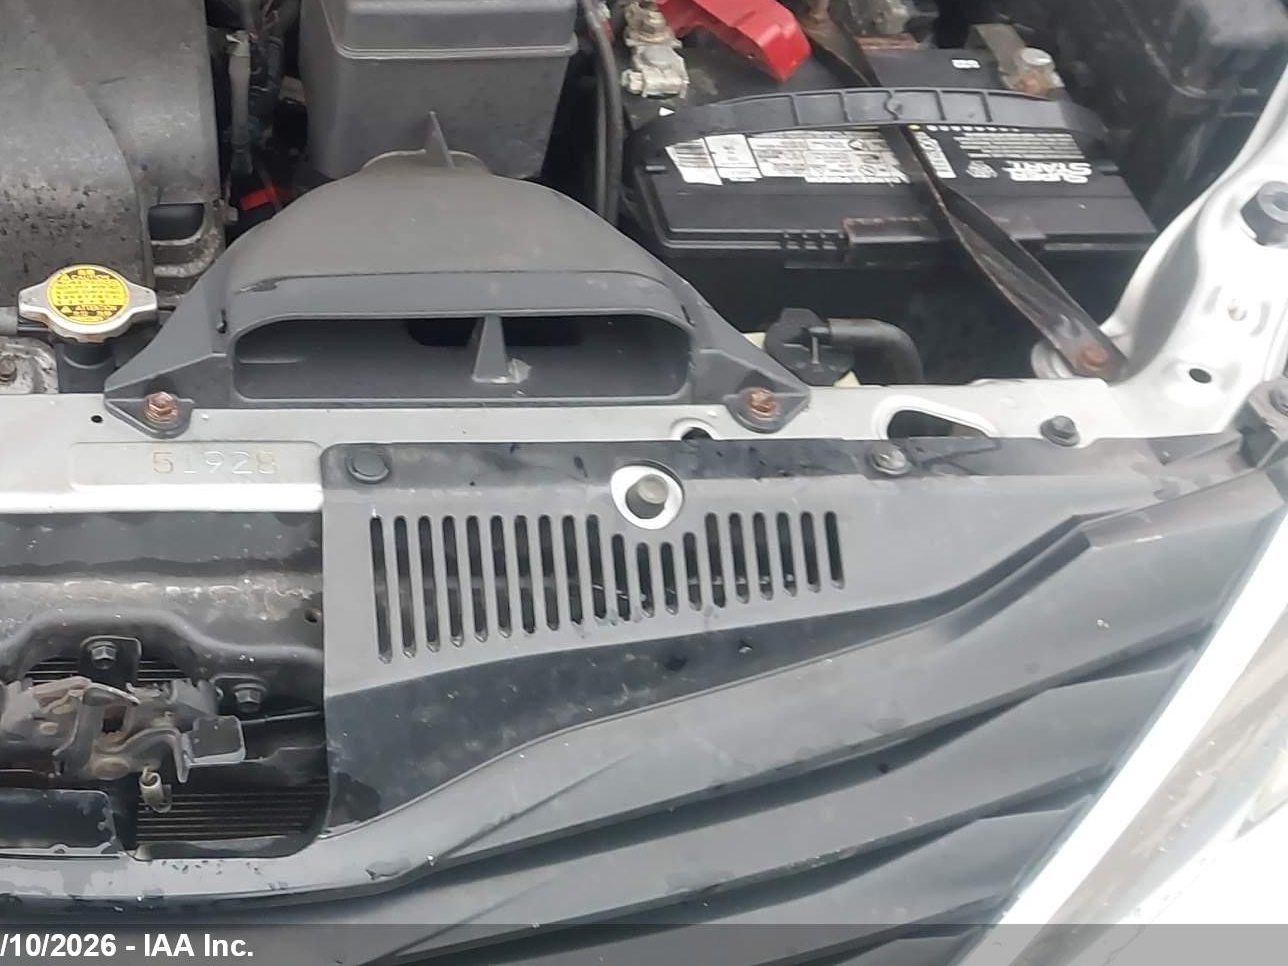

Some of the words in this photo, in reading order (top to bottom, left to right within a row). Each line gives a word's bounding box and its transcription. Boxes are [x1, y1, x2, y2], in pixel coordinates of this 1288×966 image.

[1004, 160, 1093, 177] START
[1004, 170, 1089, 184] SUPER
[152, 450, 278, 475] 51928
